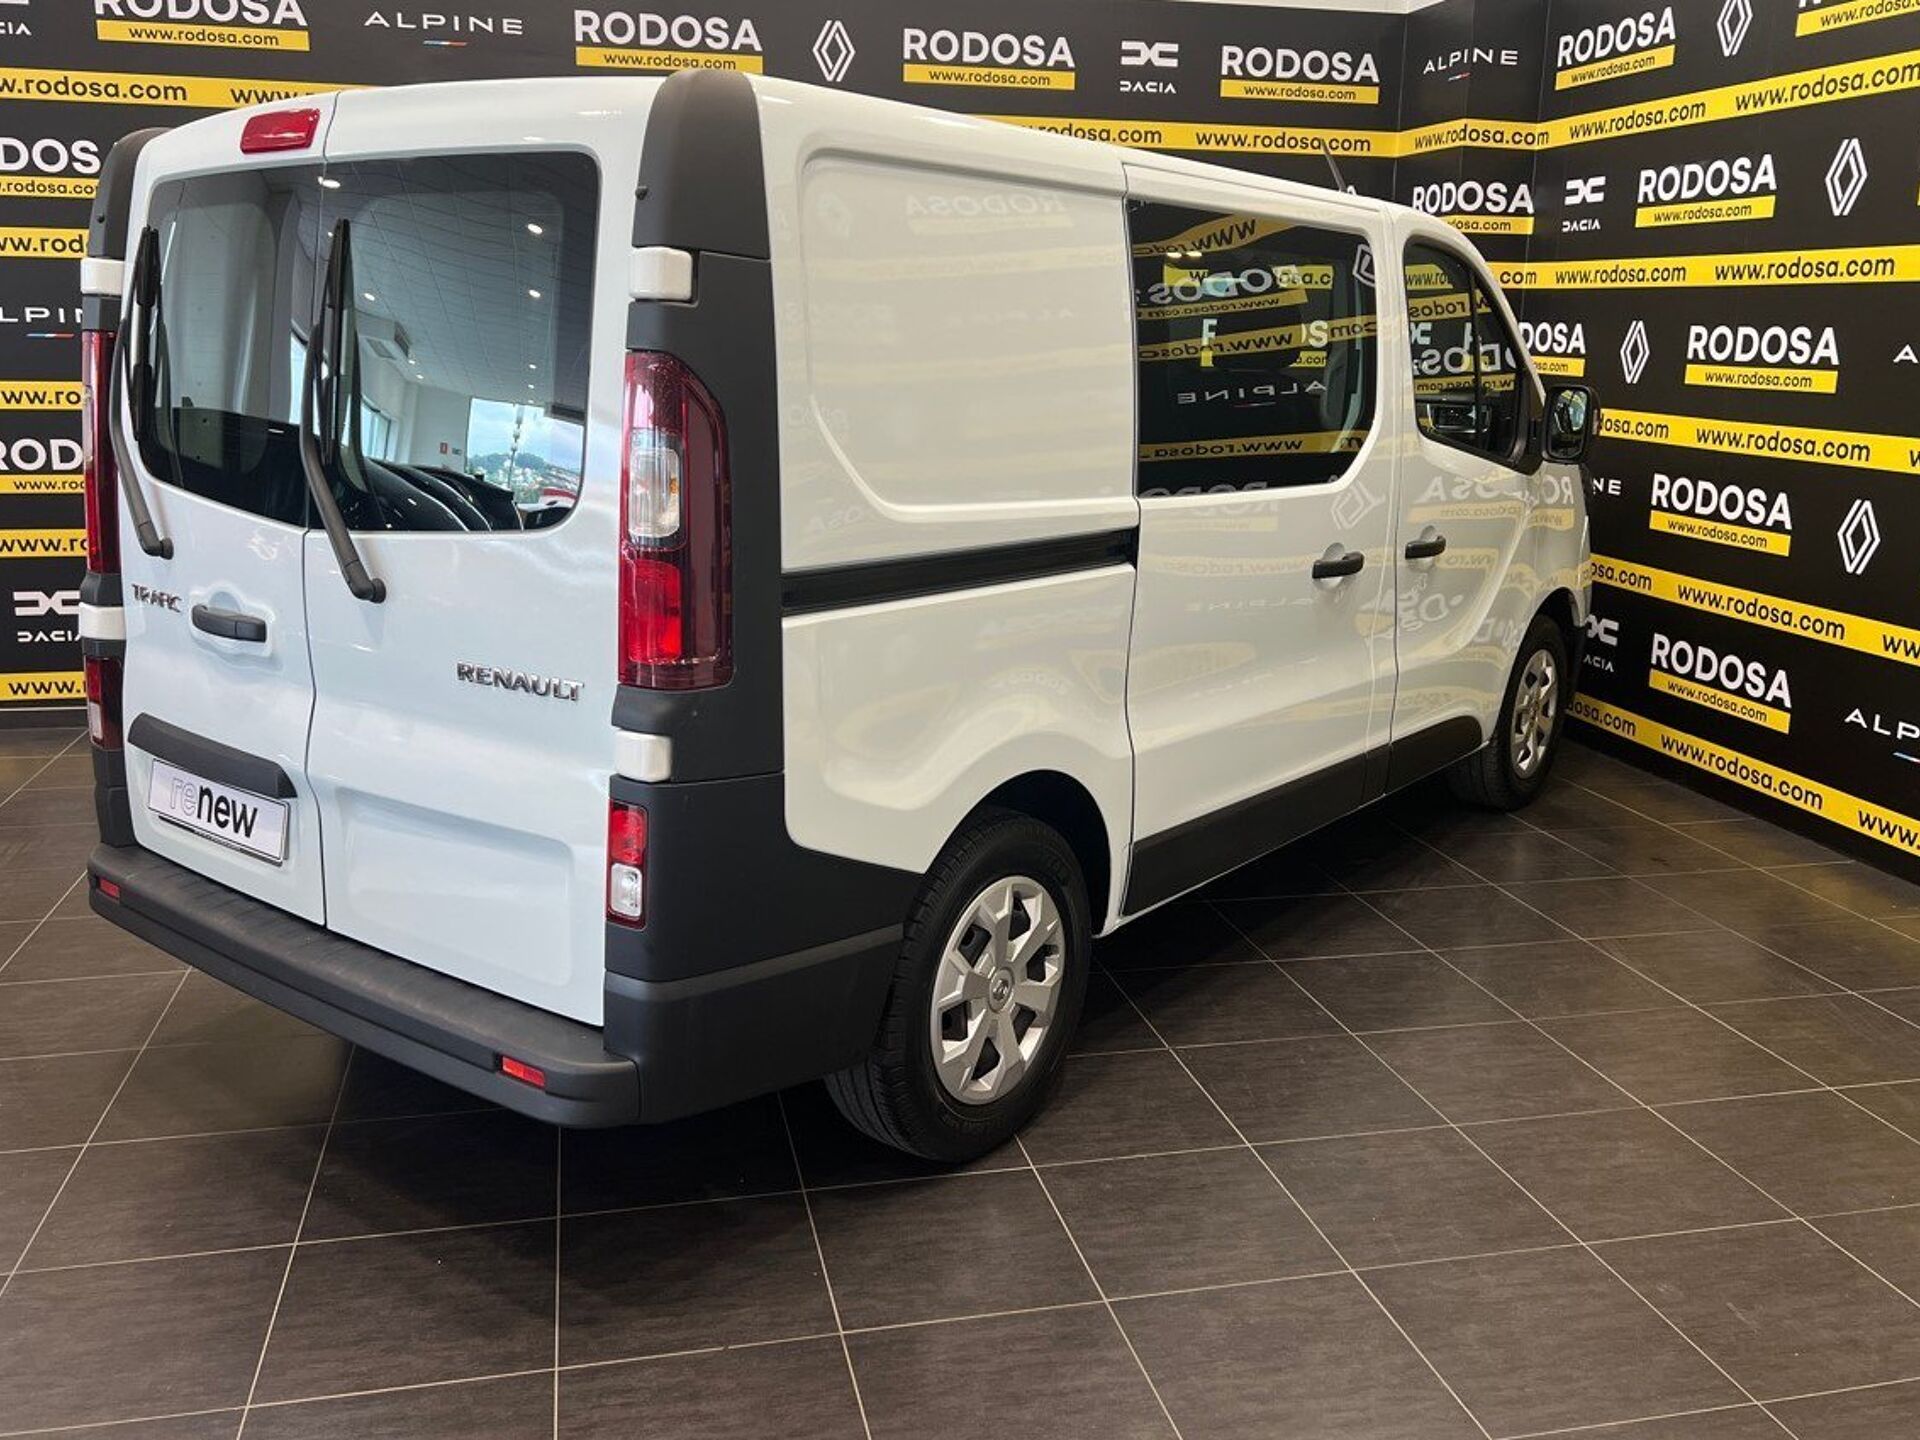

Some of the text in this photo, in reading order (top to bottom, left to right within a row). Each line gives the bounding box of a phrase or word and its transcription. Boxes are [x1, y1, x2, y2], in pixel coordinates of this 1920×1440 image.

[128, 26, 279, 46] www.rodosa.com
[364, 12, 523, 35] ALPINE
[574, 10, 763, 51] RODOSA
[1557, 7, 1676, 67] RODOSA
[604, 53, 737, 70] www.rodosa.com
[903, 28, 1076, 68] RODOSA
[1221, 45, 1380, 83] RODOSA
[1423, 48, 1519, 75] ALPINE
[929, 69, 1051, 86] www.rodosa.com
[1571, 55, 1656, 84] www.rodosa.com
[1120, 80, 1177, 94] DACIA
[1244, 84, 1357, 101] www.rodosa.com
[1736, 61, 1920, 111] www.rodosa.com
[1569, 100, 1706, 139] www.rodosa.com
[1196, 132, 1371, 152] www.rodosacom
[1415, 124, 1550, 150] www.rodosa.com
[1637, 154, 1778, 204] RODOSA
[1412, 181, 1535, 215] RODOSA
[1654, 203, 1752, 223] www.rodosa.com
[1562, 219, 1601, 232] DACIA
[1555, 263, 1687, 286] www.rodosa.com
[1715, 255, 1895, 281] www.rodosa.com
[1519, 322, 1586, 354] DOSA
[1687, 325, 1840, 366] RODOSA
[1705, 370, 1813, 388] www.rodosa.com
[1696, 427, 1871, 462] www.rodosa.com
[1651, 473, 1793, 530] RODOSA
[1668, 518, 1768, 548] www.rodosa.com
[1677, 584, 1846, 641] www.rodosa.com
[456, 660, 585, 701] RENAULT
[1651, 632, 1792, 708] RODOSA
[9, 681, 87, 695] www.
[1667, 680, 1768, 722] www.rodosa.com
[1660, 734, 1824, 810] www.rodosa.com
[170, 777, 258, 838] renew
